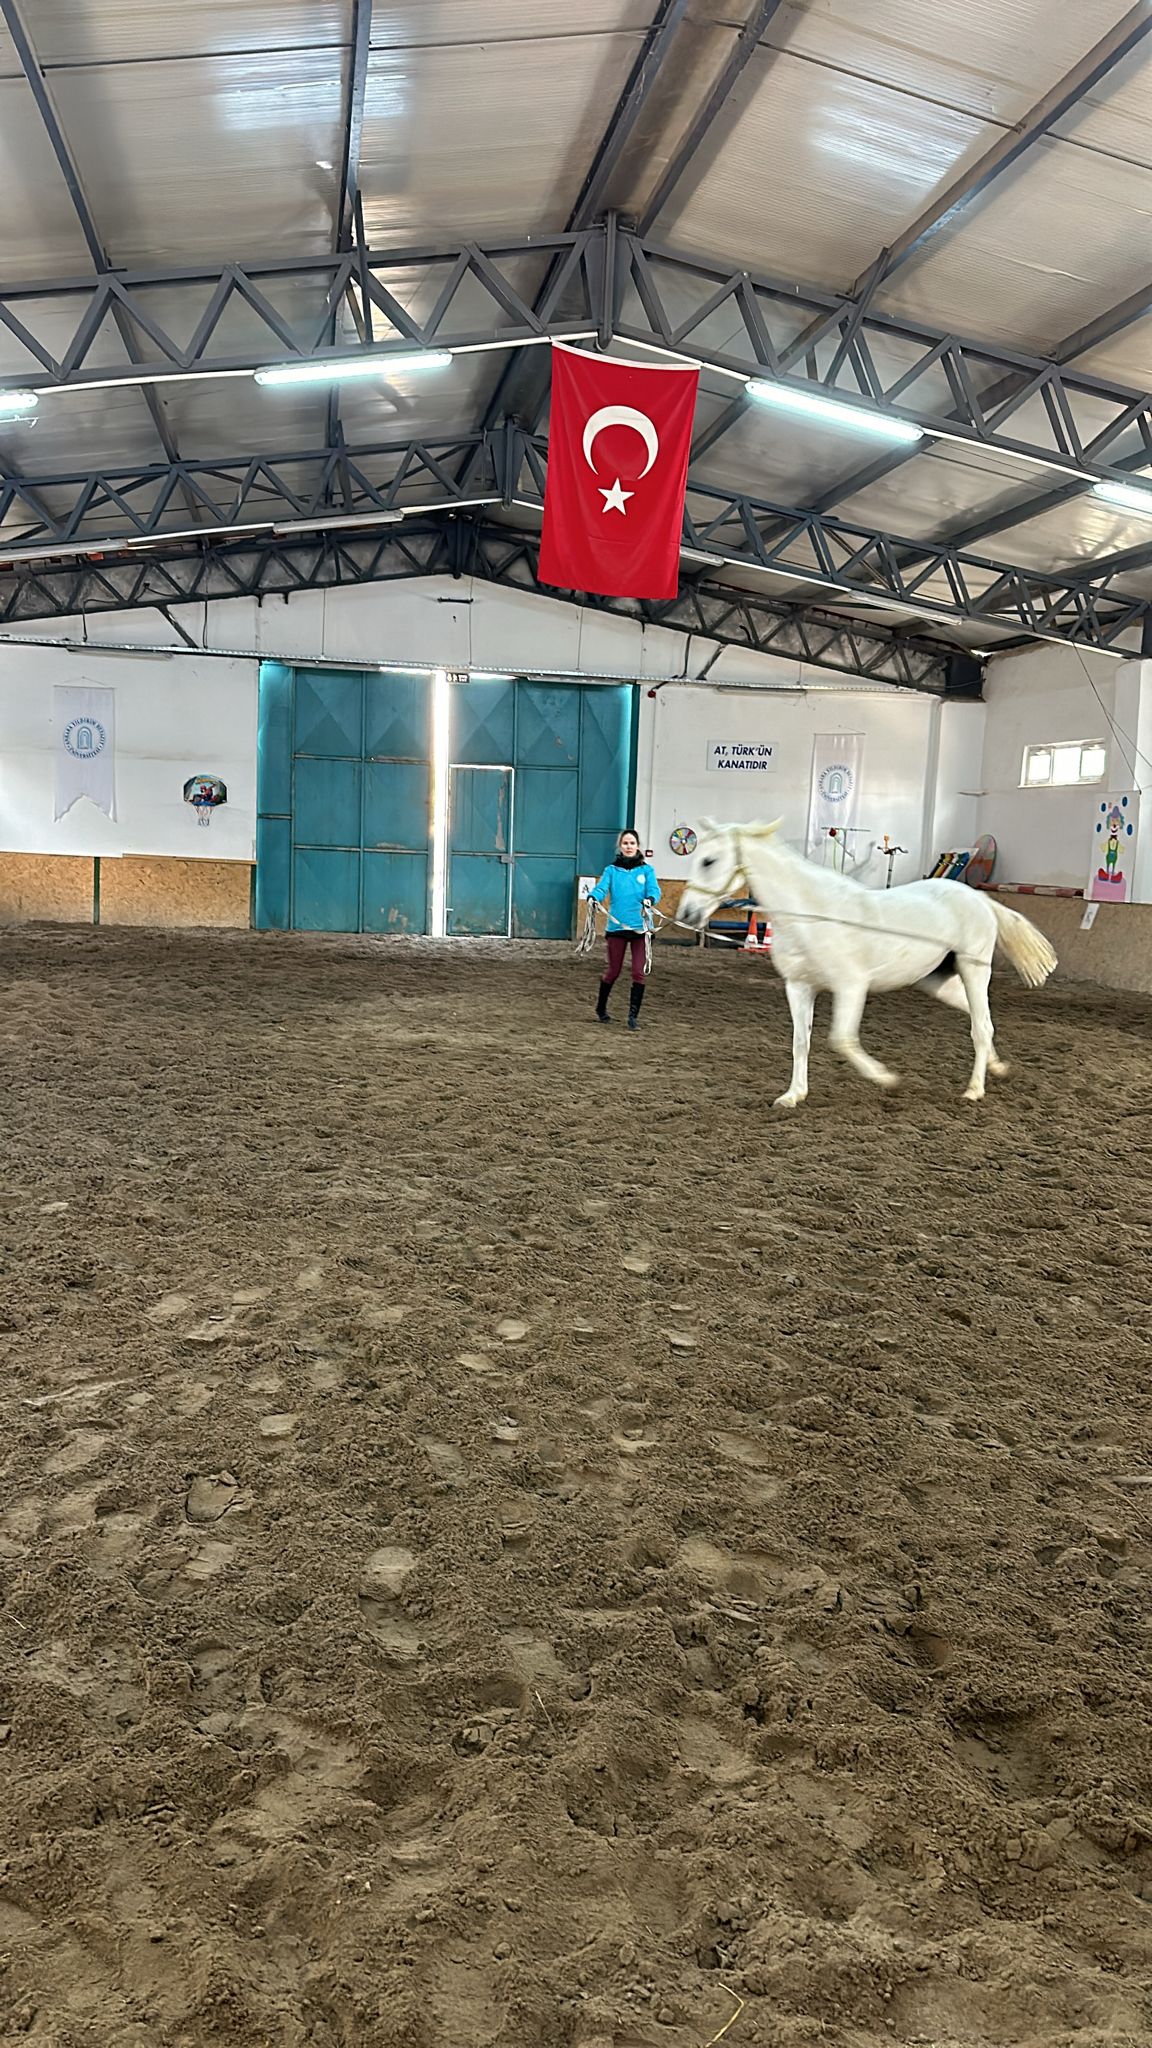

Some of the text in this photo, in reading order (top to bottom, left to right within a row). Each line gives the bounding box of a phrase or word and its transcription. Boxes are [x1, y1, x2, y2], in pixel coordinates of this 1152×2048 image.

[714, 744, 772, 756] AT, TÜRK'ÜN
[718, 760, 768, 769] KANATIDIR
